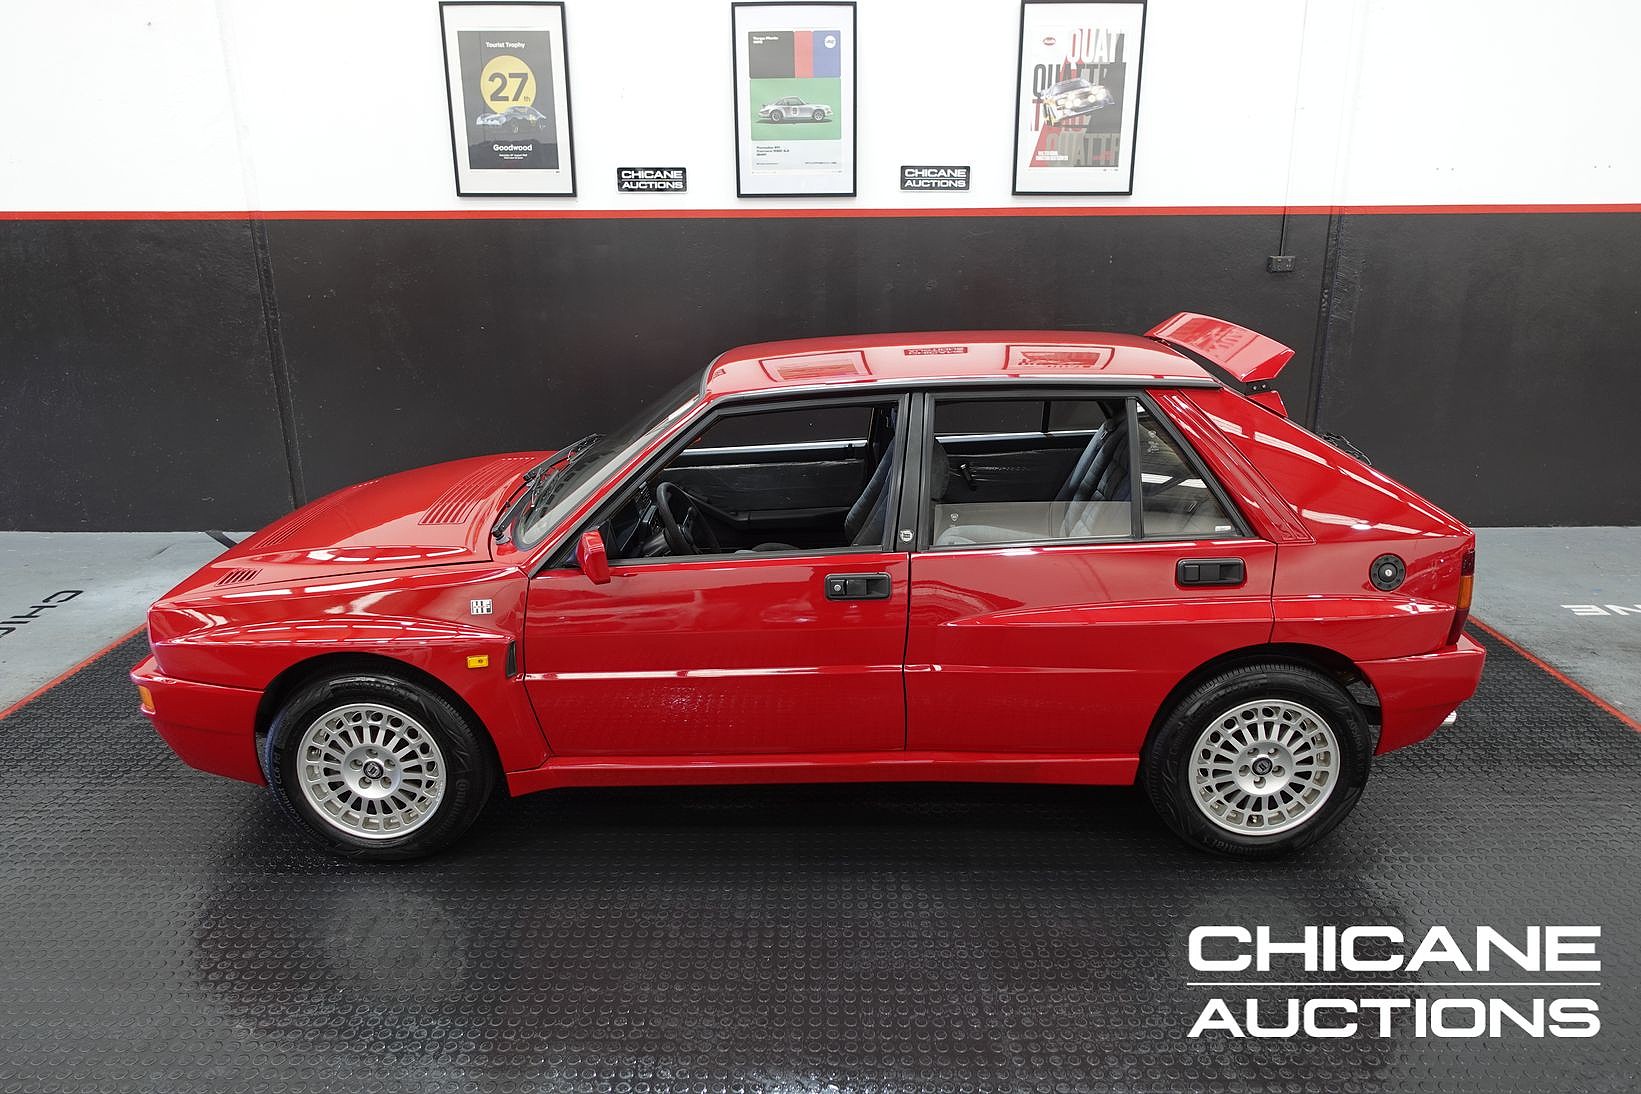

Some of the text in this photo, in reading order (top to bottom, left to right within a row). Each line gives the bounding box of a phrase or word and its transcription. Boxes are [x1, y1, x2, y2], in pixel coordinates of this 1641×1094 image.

[488, 72, 529, 103] 27
[621, 170, 683, 179] CHICANE
[905, 169, 967, 177] CHICANE
